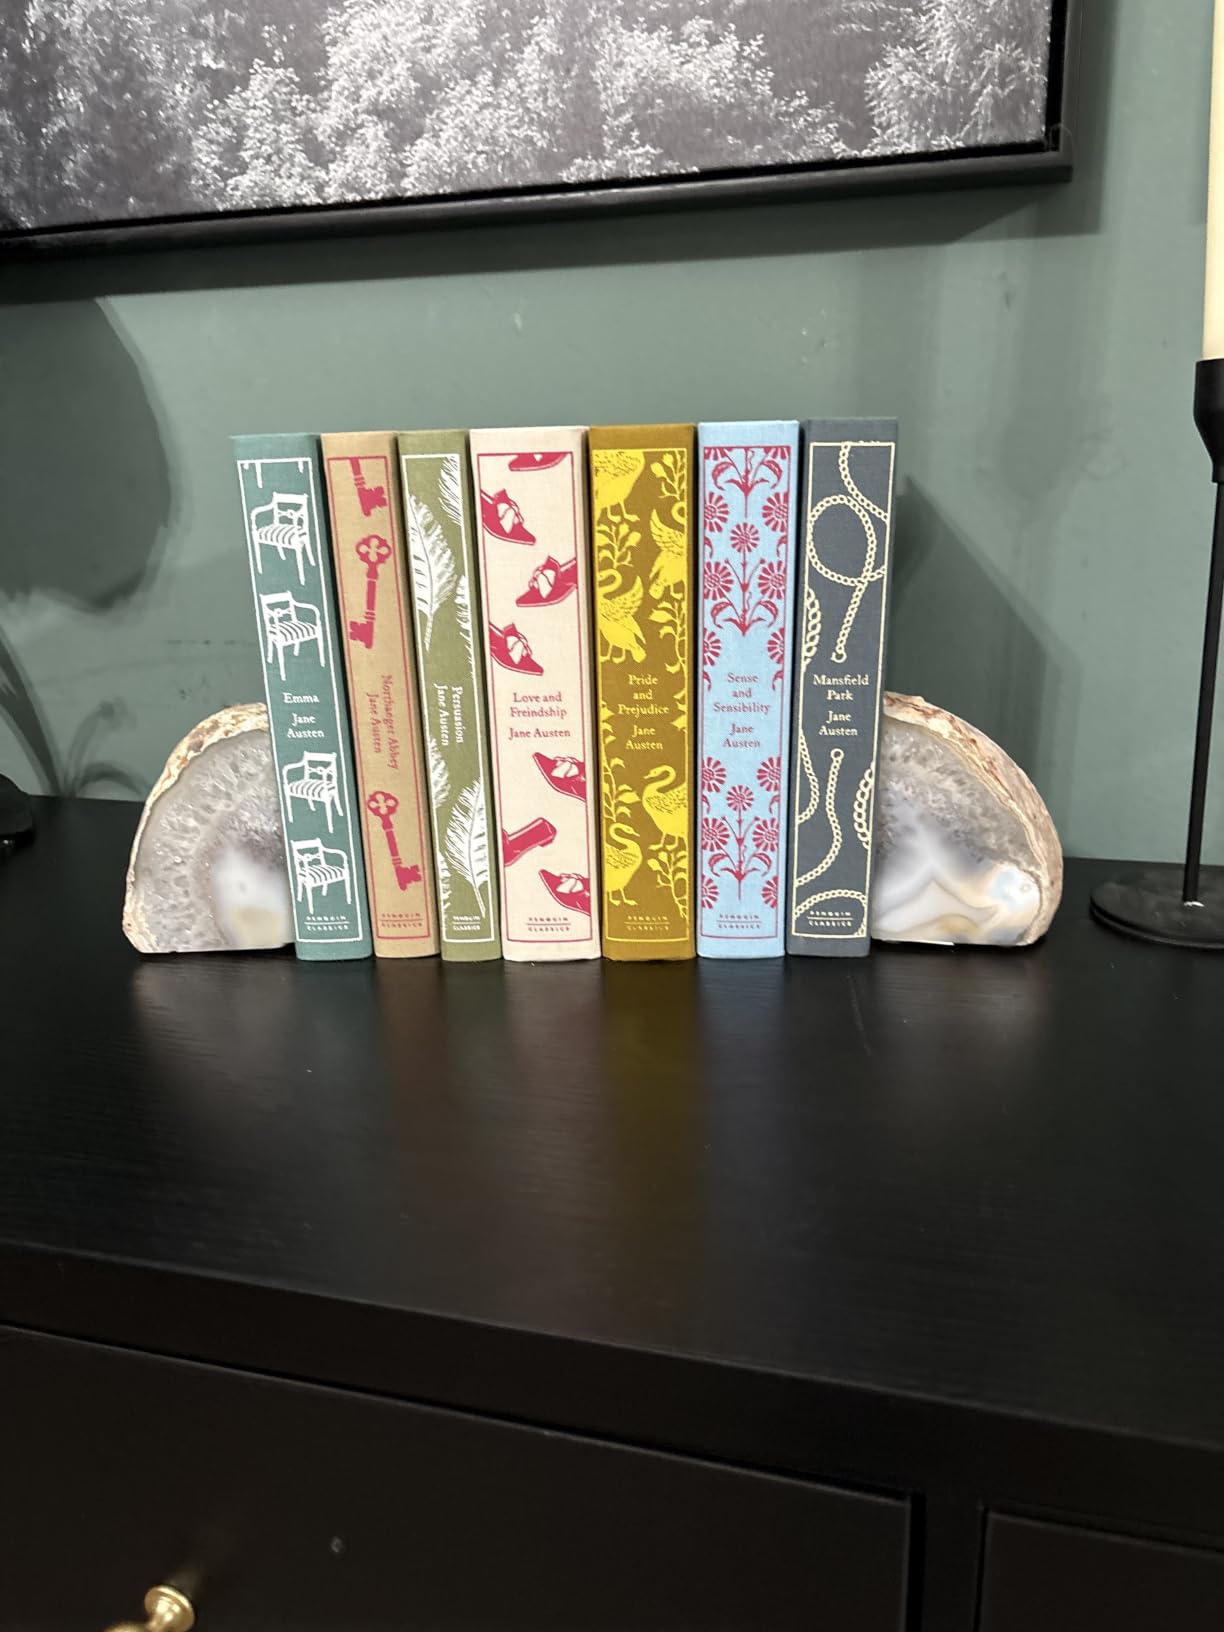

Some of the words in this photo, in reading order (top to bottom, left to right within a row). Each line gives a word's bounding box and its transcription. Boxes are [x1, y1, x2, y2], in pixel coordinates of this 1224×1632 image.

[628, 674, 658, 686] Pride
[727, 673, 759, 683] Sense
[813, 674, 869, 686] Mansfield
[282, 692, 320, 704] Emma
[433, 683, 448, 707] Jane
[513, 692, 540, 703] Love
[542, 692, 562, 702] and
[633, 689, 653, 700] and
[732, 688, 752, 699] and
[826, 690, 853, 701] Park
[366, 692, 379, 715] Jane
[381, 675, 395, 734] Northanger
[713, 702, 771, 714] Sensibility
[452, 686, 466, 743] Persuasion
[509, 707, 567, 719] Freindship
[617, 704, 669, 718] Prejudice
[826, 710, 852, 723] Jane
[291, 713, 316, 727] Jane
[286, 728, 325, 739] Austen
[439, 709, 450, 746] Austen
[508, 728, 531, 740] Jane
[534, 727, 571, 737] Austen
[631, 724, 656, 737] Jane
[730, 724, 754, 735] Jane
[818, 726, 858, 736] Austen
[370, 717, 382, 753] Austen
[625, 740, 663, 750] Austen
[722, 737, 761, 748] Austen
[387, 737, 400, 769] Abbey
